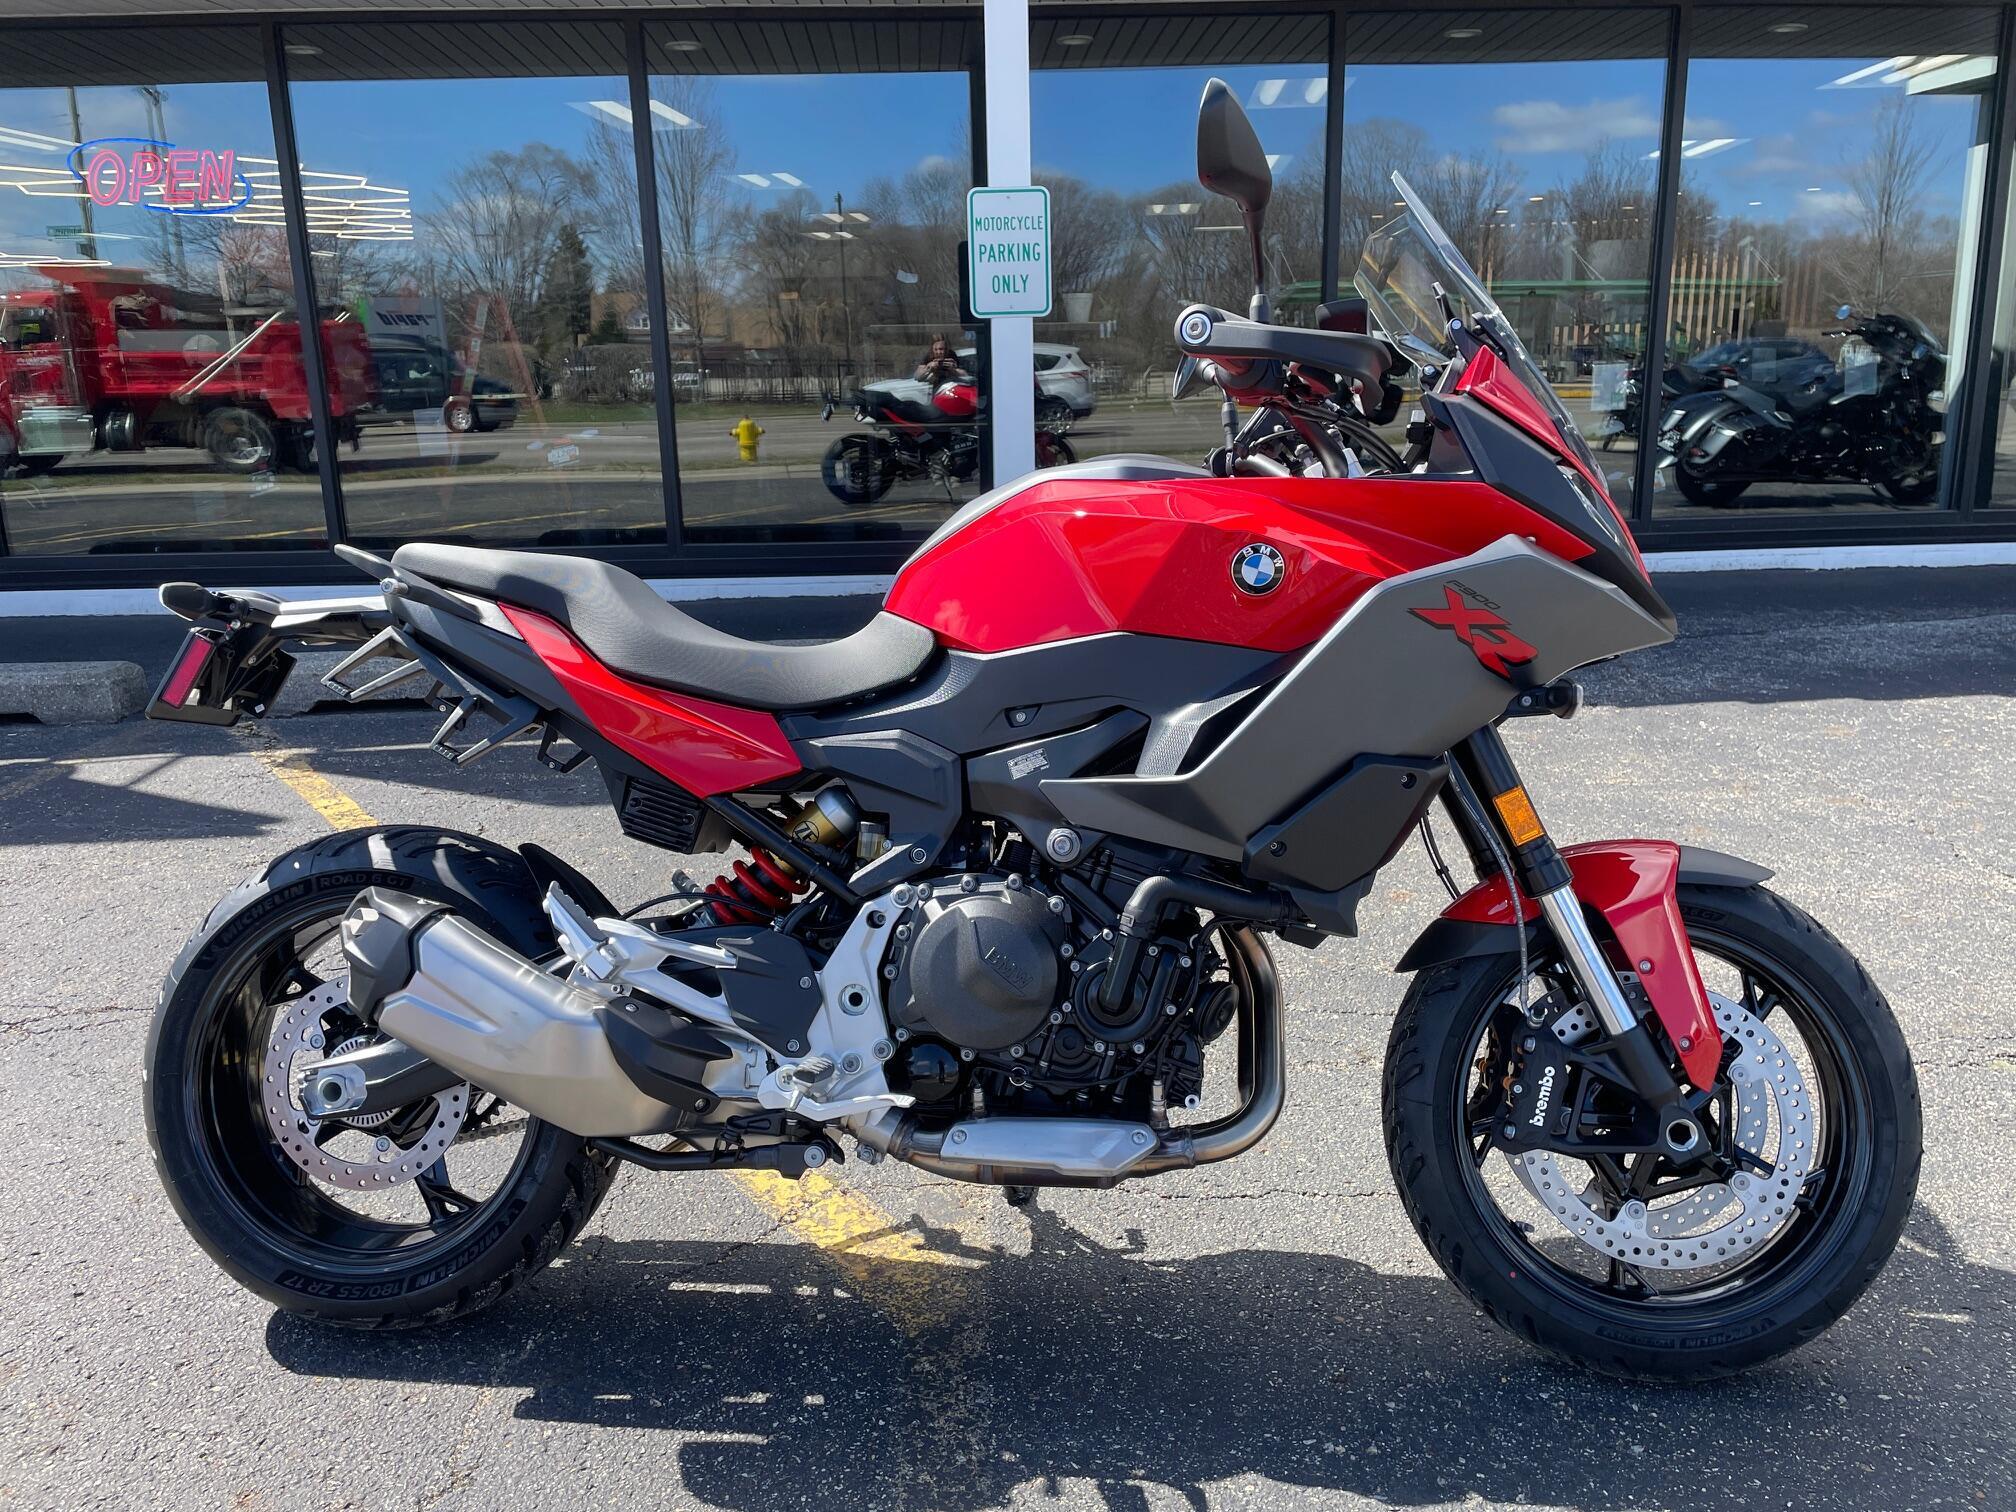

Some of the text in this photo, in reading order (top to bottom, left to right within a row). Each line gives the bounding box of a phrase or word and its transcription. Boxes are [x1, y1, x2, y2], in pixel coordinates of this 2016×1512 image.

[87, 150, 234, 206] OPEN
[975, 215, 1044, 231] MOTORCYCLE
[979, 243, 1041, 263] PARKING
[992, 274, 1029, 294] ONLY
[1446, 580, 1501, 610] F900
[1407, 584, 1538, 684] XR
[222, 883, 305, 944] MICHELIN
[320, 874, 367, 887] ROAD
[388, 876, 409, 887] GT
[985, 946, 1033, 989] BMW
[1529, 1066, 1556, 1127] brembo
[283, 1224, 500, 1299] MICHELIN 180/55 ZR 17
